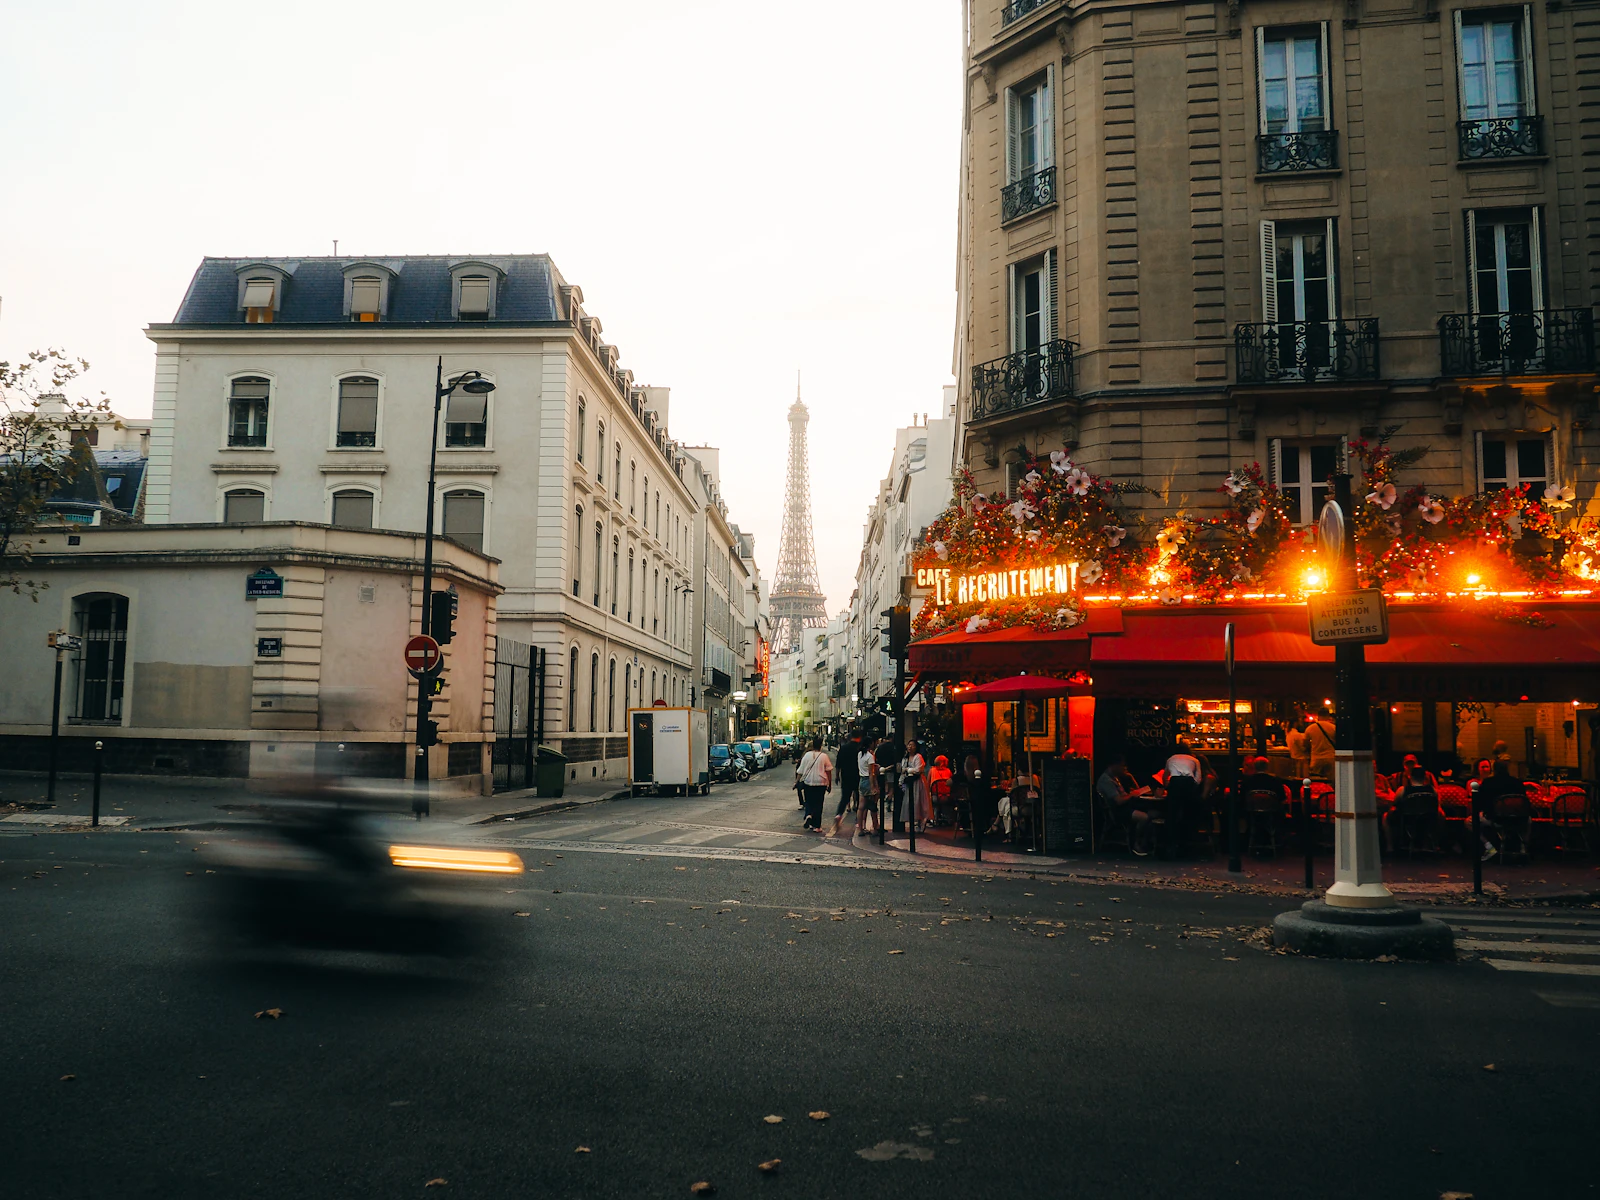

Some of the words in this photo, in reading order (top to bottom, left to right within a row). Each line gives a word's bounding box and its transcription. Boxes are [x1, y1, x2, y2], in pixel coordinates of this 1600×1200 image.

[936, 578, 952, 606] LE
[958, 562, 1080, 605] RECRUTEMENT
[1321, 606, 1369, 618] ATTENTION
[1332, 618, 1351, 627] BUS
[1354, 617, 1361, 625] A
[1318, 625, 1378, 638] CONTRESENS
